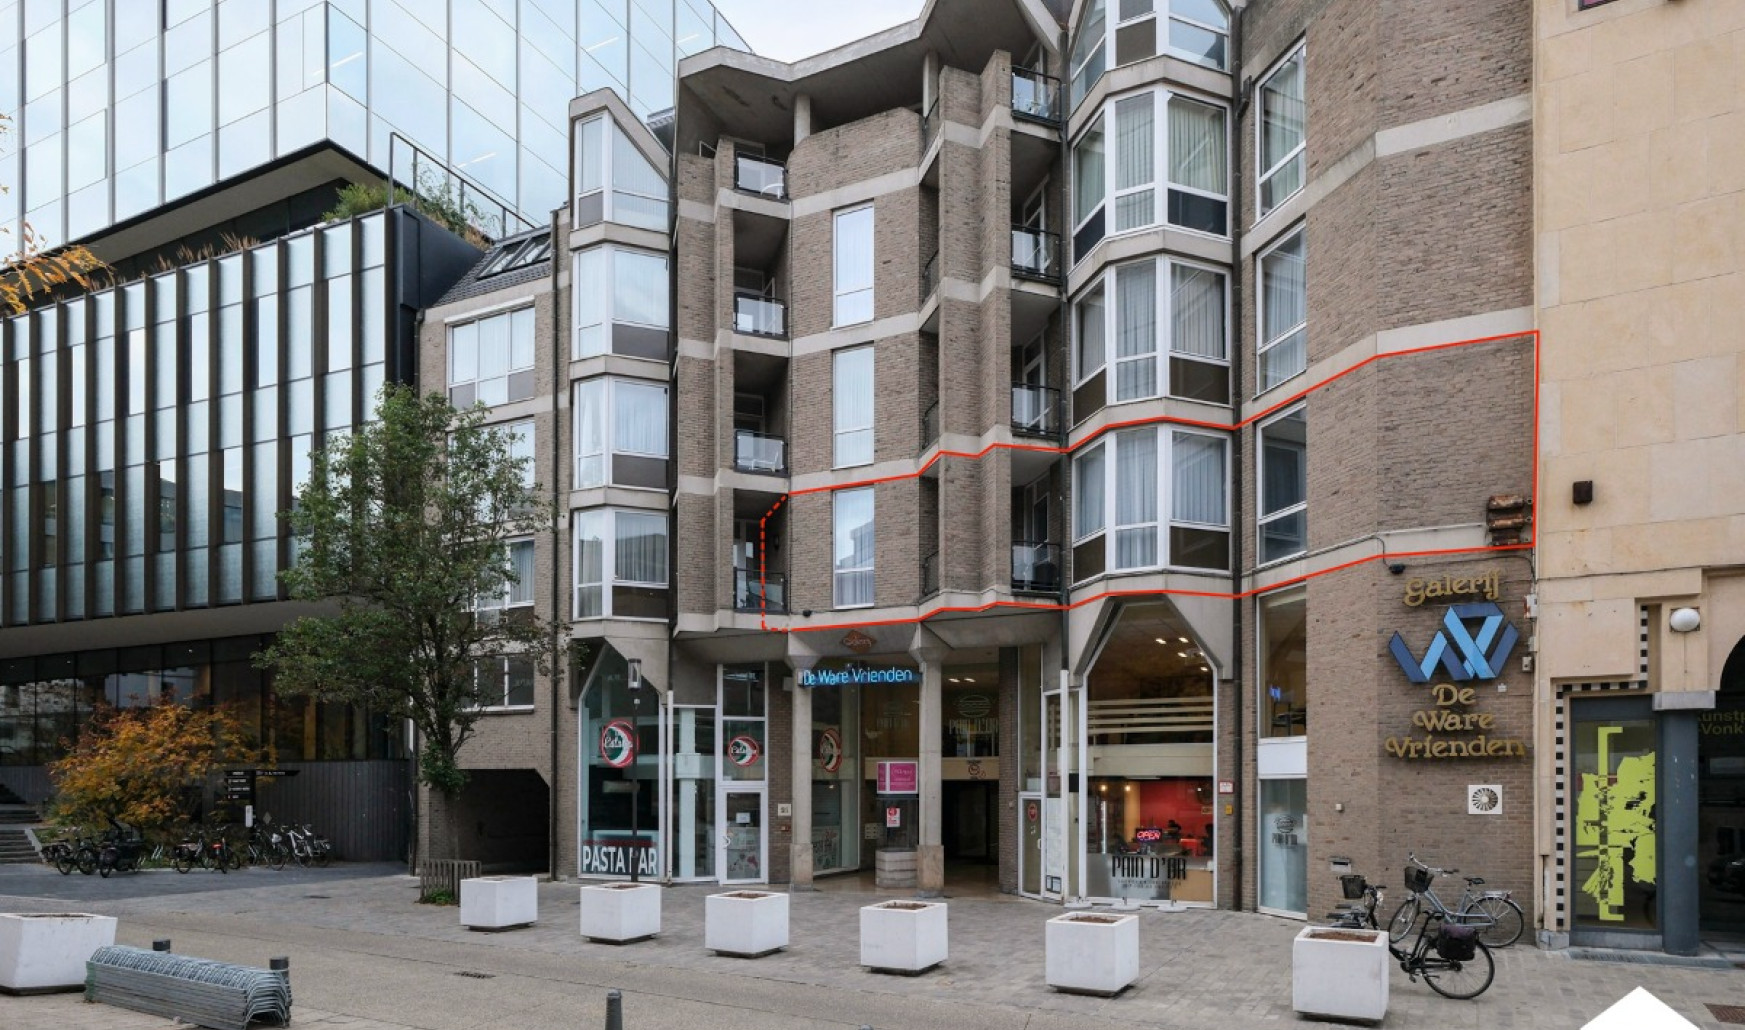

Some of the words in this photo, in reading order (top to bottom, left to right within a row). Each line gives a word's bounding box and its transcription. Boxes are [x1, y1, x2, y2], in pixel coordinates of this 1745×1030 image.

[803, 669, 816, 686] De
[818, 669, 849, 686] Ware
[852, 666, 913, 683] Vrienden
[1432, 683, 1477, 706] De
[1413, 710, 1497, 732] Ware
[1385, 735, 1526, 759] Vrienden
[582, 845, 626, 873] PASTA
[1112, 855, 1144, 878] PAIN
